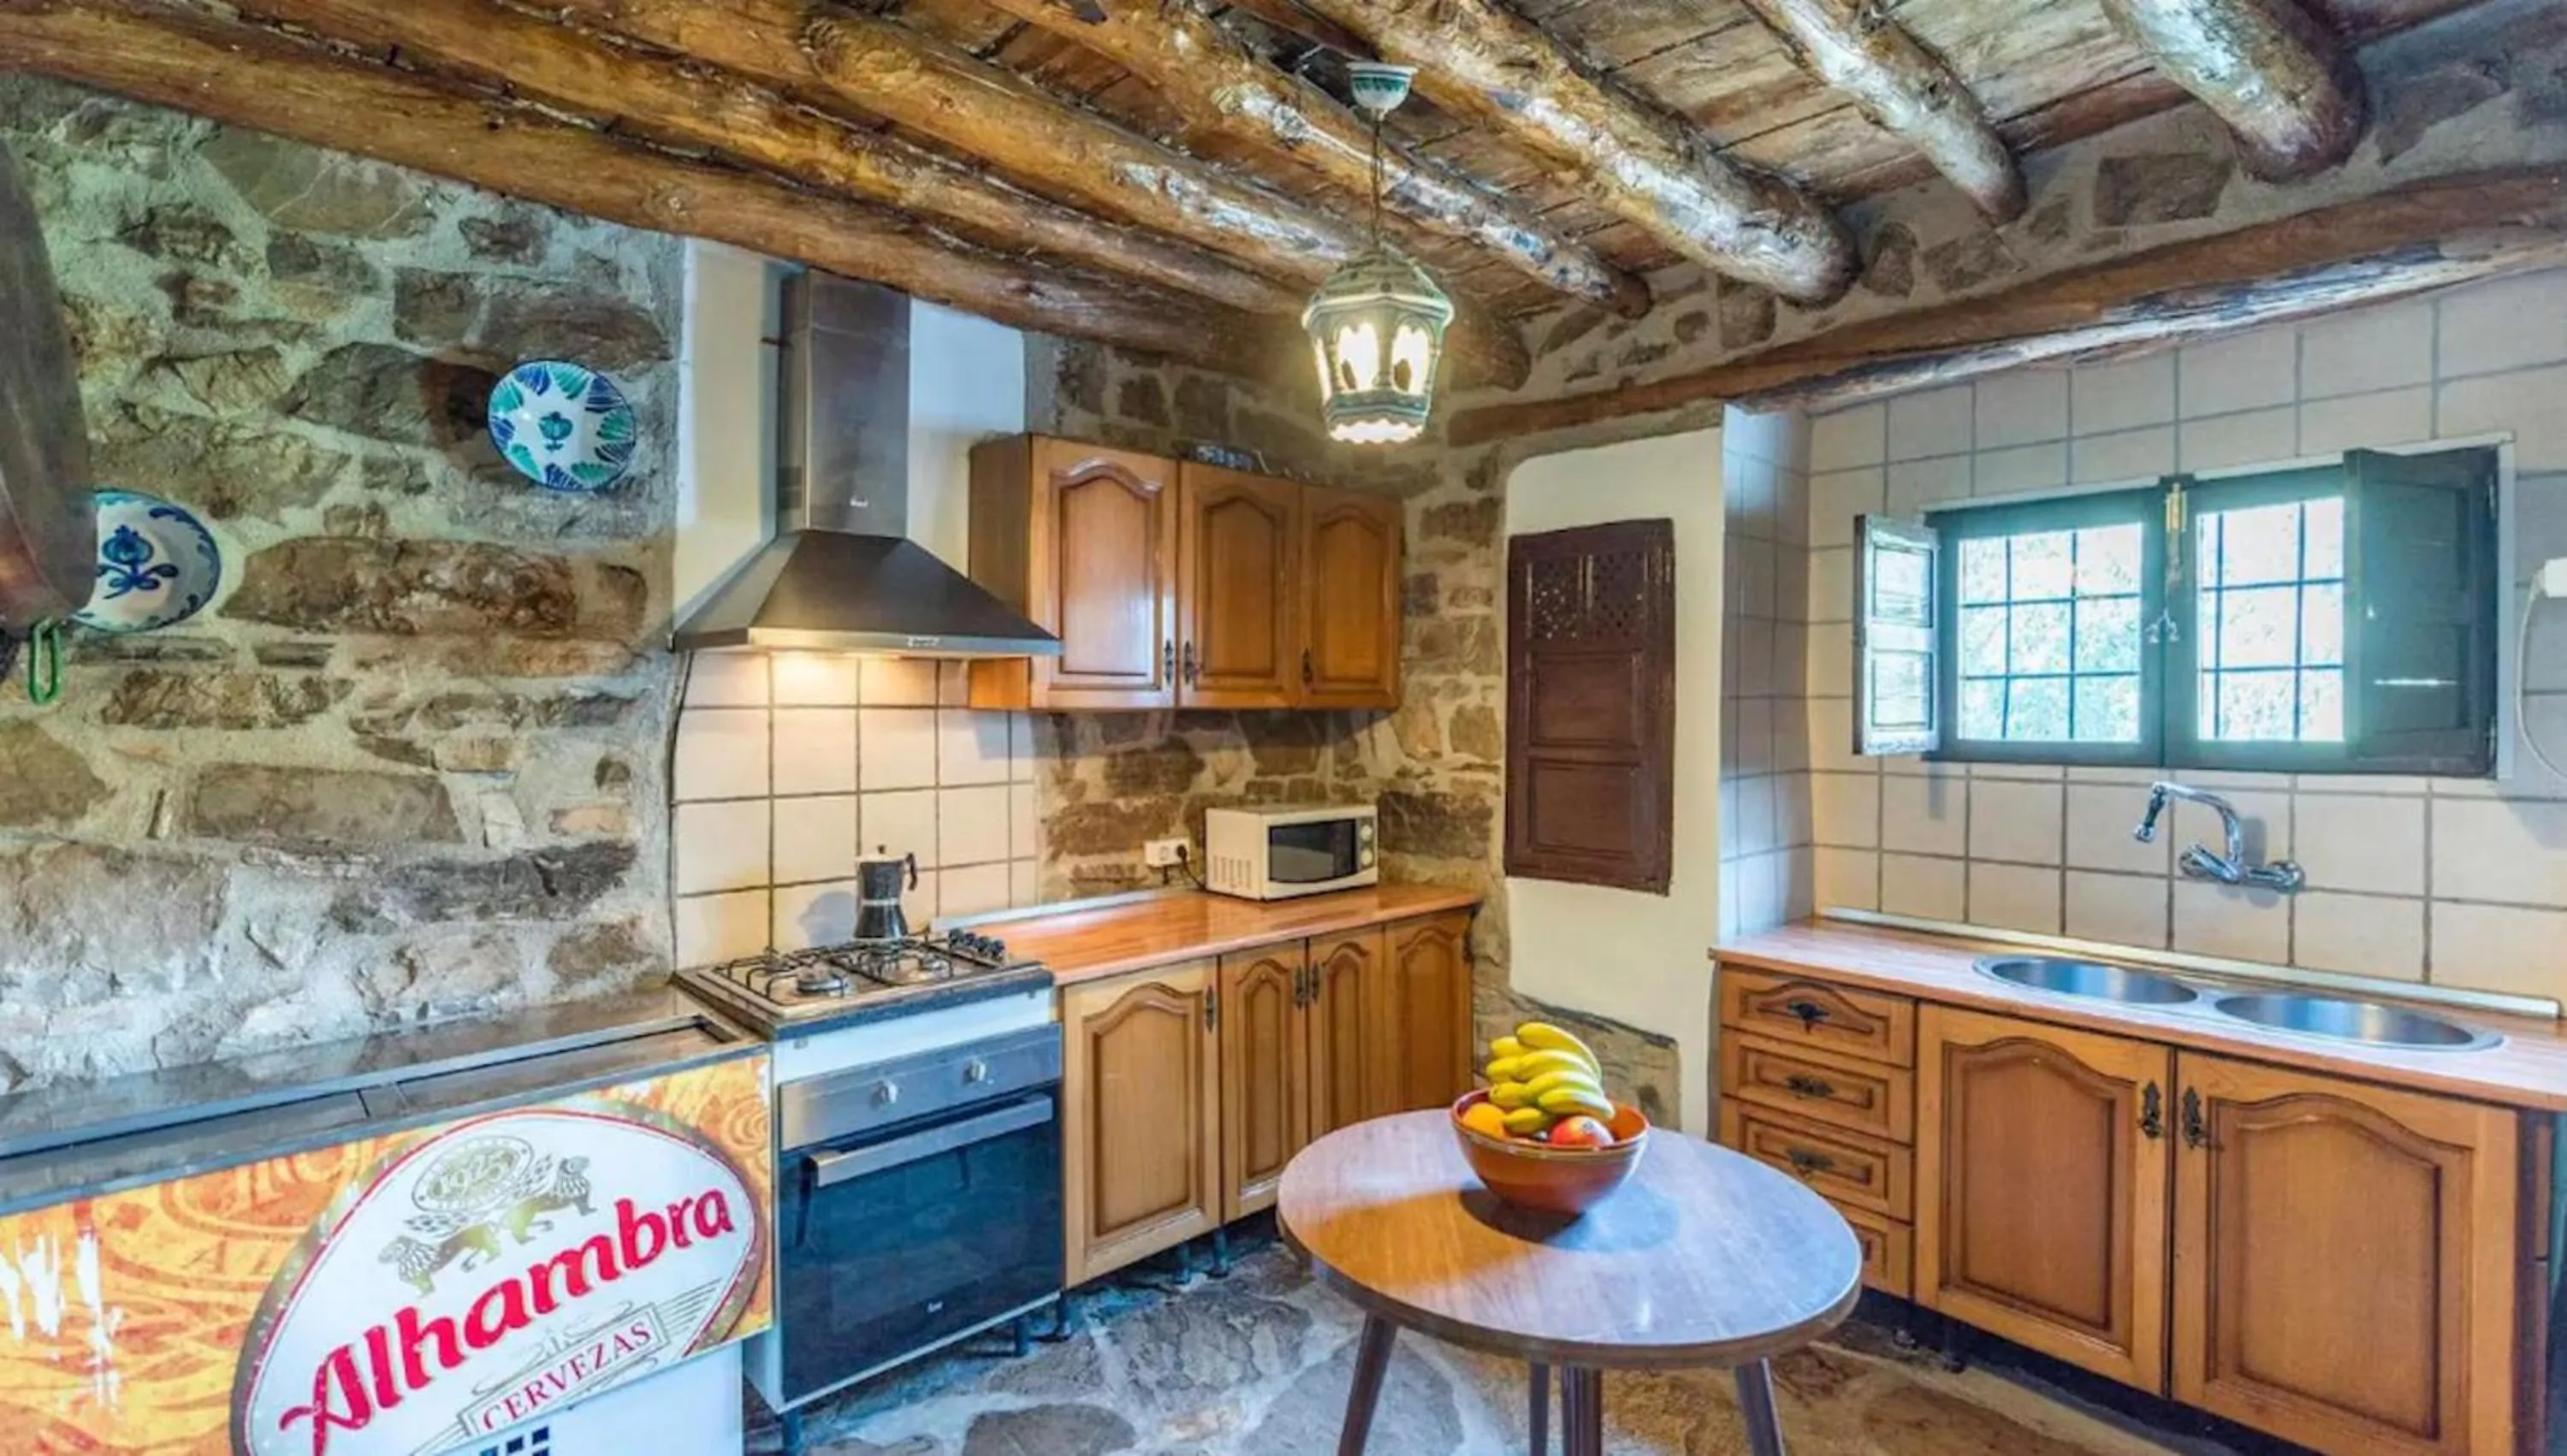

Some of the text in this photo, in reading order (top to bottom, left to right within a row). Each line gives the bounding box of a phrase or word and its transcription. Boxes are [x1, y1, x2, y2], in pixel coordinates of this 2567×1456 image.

[440, 1150, 514, 1197] 1925
[279, 1188, 734, 1456] Alhambra
[483, 1321, 652, 1430] CERVEZAS
